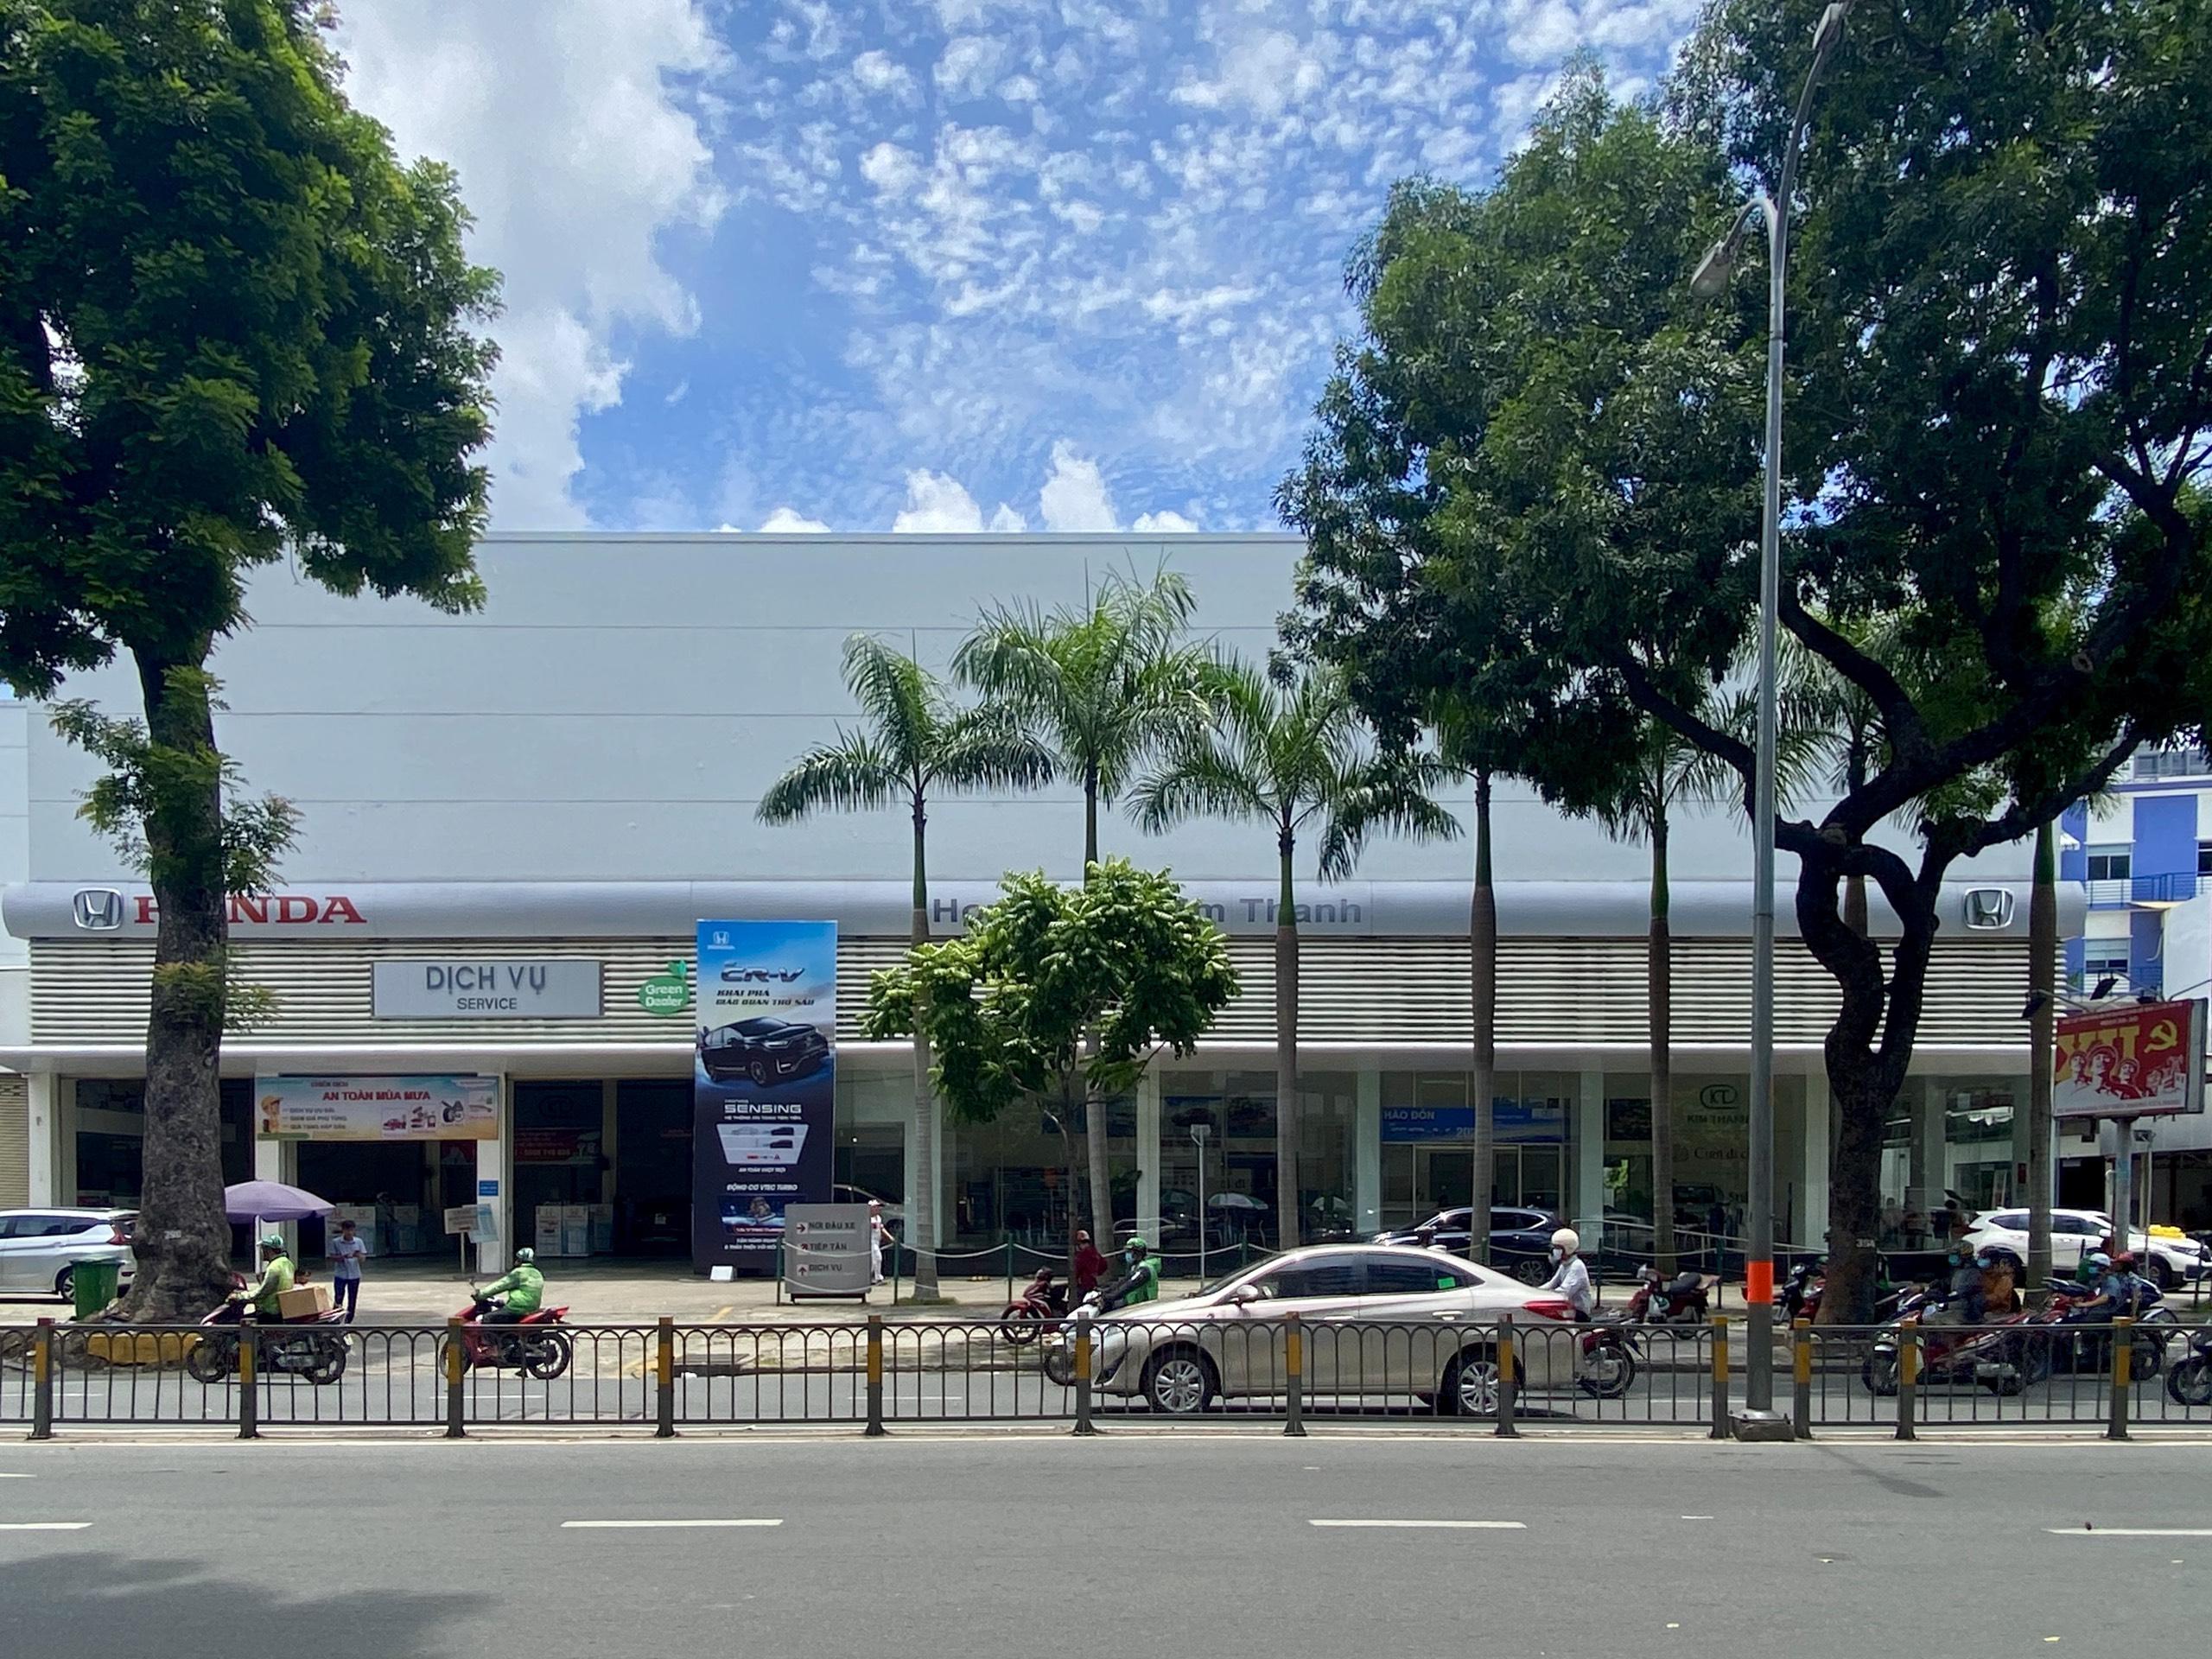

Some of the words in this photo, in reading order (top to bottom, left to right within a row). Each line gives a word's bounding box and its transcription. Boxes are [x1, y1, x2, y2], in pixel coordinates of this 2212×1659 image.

[133, 896, 367, 924] HNDA
[1239, 898, 1362, 923] Thanh
[426, 966, 496, 995] DỊCH
[508, 966, 546, 995] VỤ
[645, 984, 683, 995] Green
[456, 997, 518, 1010] SERVICE
[645, 995, 683, 1007] Dealer
[323, 1091, 339, 1100] AN
[342, 1090, 373, 1100] TOÀN
[724, 1104, 802, 1114] SENSING
[1384, 1109, 1408, 1120] HÀO
